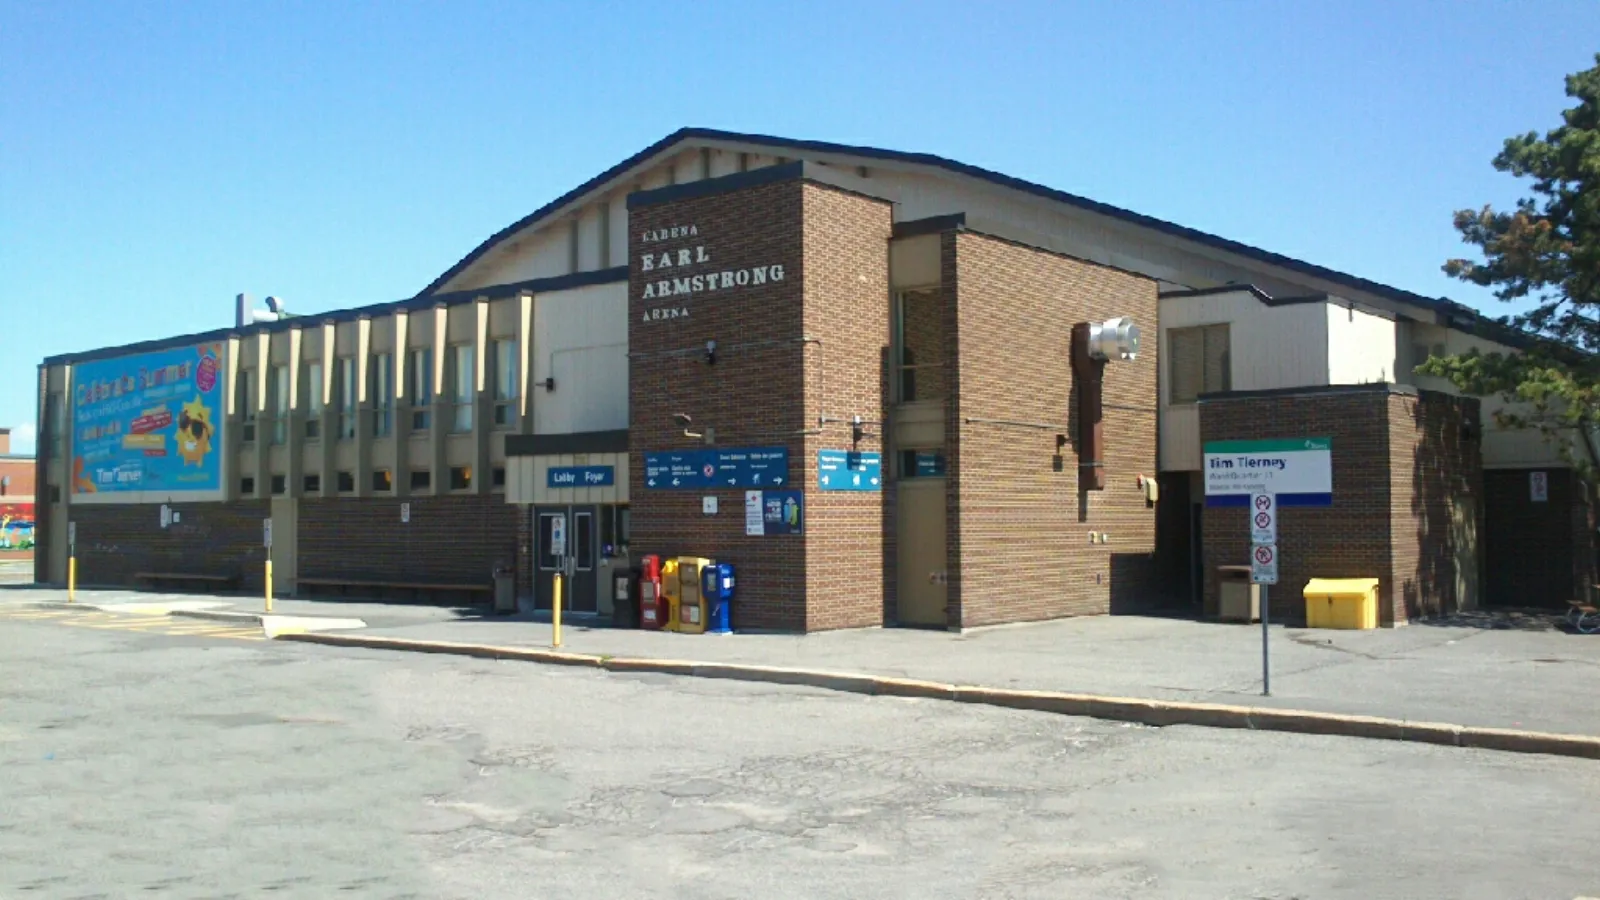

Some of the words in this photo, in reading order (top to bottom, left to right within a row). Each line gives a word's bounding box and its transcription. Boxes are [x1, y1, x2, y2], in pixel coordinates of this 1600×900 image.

[641, 246, 710, 271] EARL
[641, 264, 785, 299] ARMSTRONG
[643, 307, 689, 322] ARENA
[1209, 457, 1234, 469] Tim
